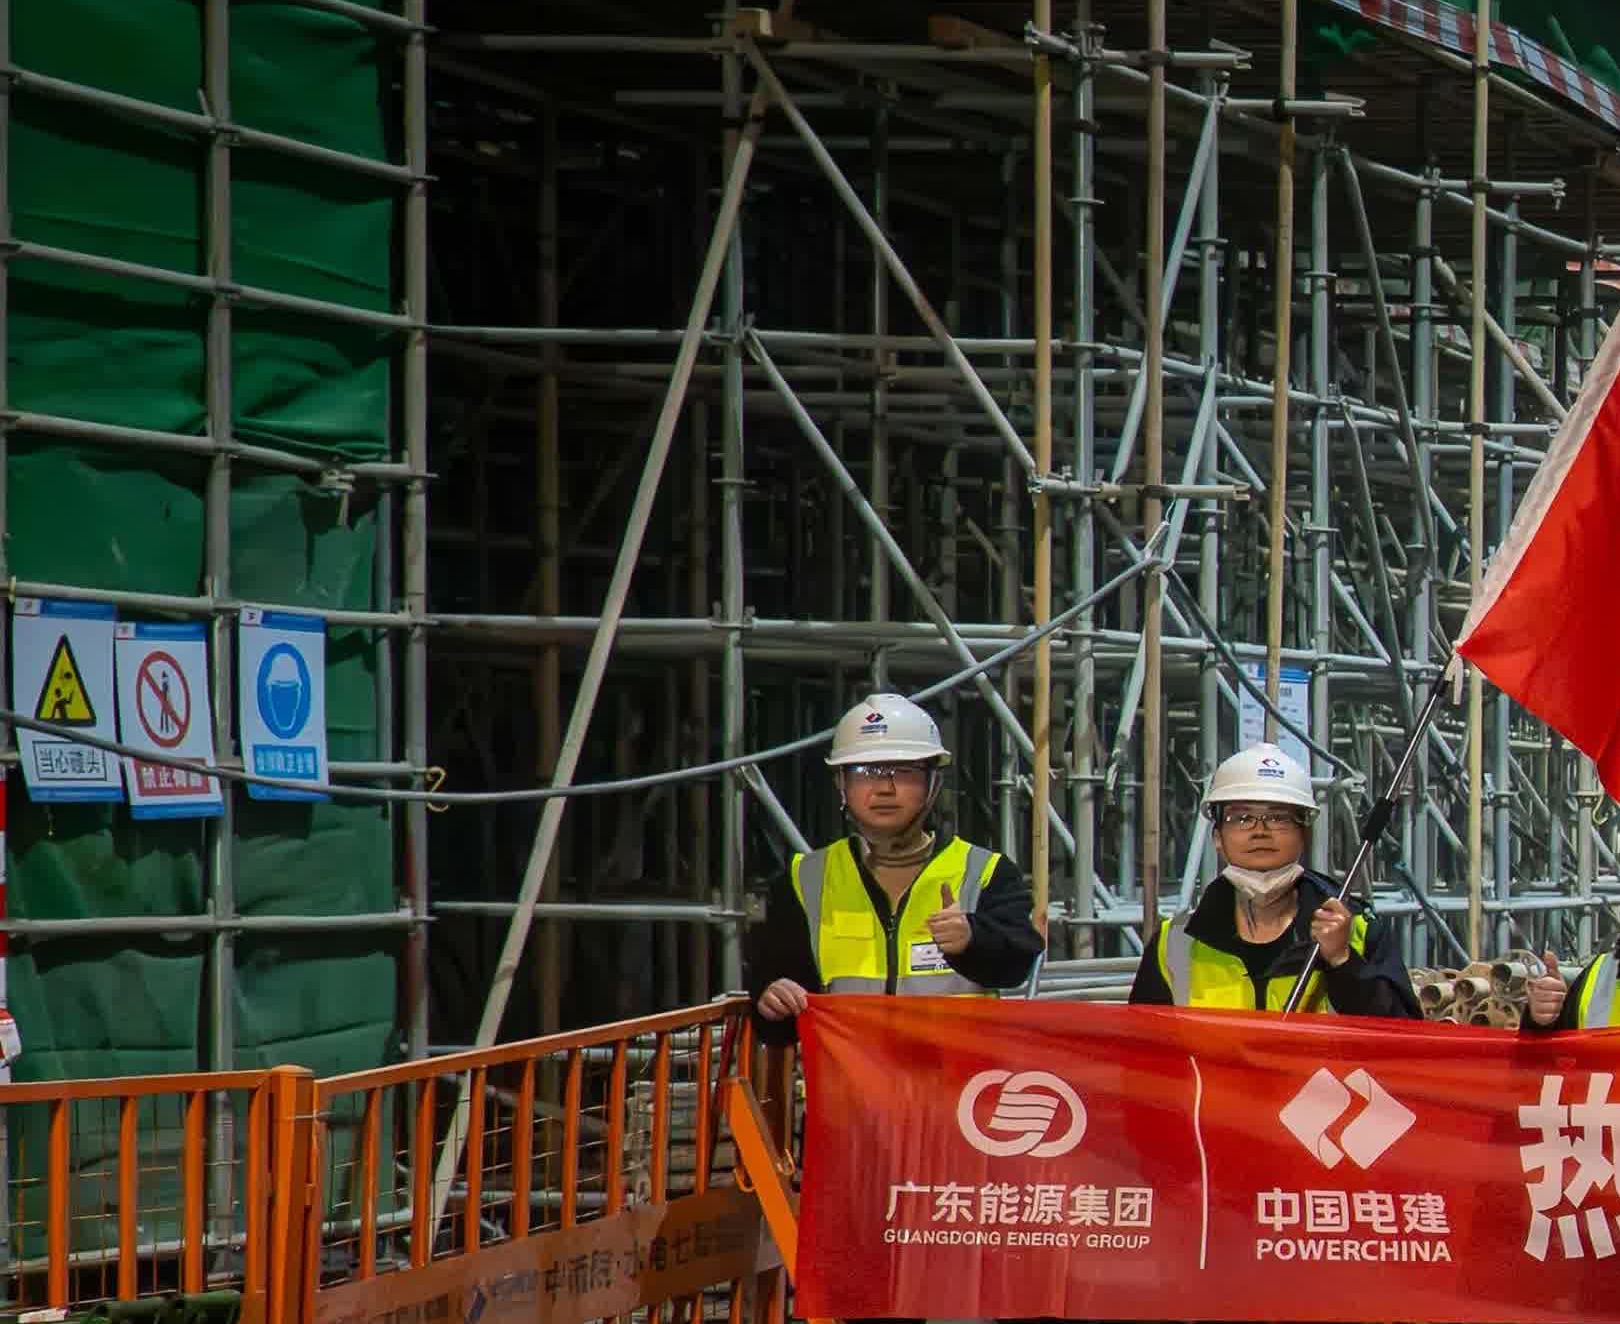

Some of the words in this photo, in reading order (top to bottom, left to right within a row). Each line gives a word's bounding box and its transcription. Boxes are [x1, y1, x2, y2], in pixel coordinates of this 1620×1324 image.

[886, 1181, 1154, 1228] 广东能源集团
[1256, 1188, 1452, 1235] 中国电建
[884, 1228, 1001, 1248] GUANGDONG
[1006, 1231, 1081, 1249] ENERGY
[1086, 1233, 1152, 1250] GROUP
[1256, 1238, 1453, 1263] POWERCHINA
